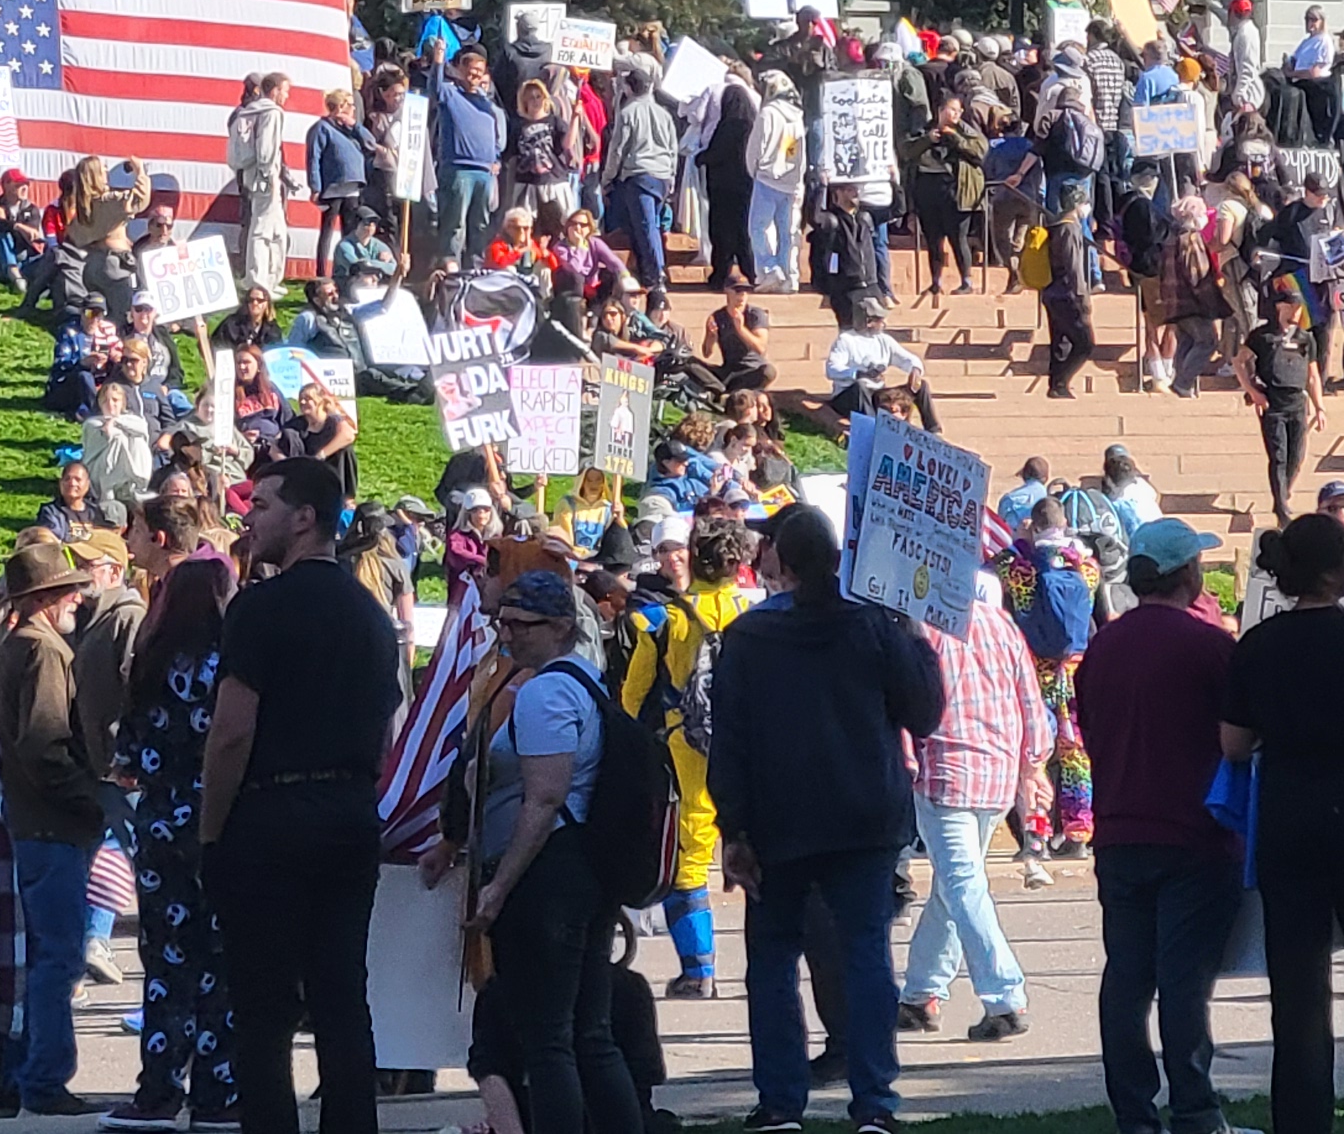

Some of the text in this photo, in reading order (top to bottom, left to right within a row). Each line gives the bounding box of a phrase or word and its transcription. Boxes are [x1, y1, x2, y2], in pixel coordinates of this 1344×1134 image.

[556, 49, 602, 66] FOR ALL
[866, 140, 888, 161] ICE
[148, 245, 225, 281] Genocide
[156, 270, 226, 316] BAD
[465, 364, 509, 397] DA
[511, 367, 581, 390] ELECT A
[605, 367, 650, 395] KINGS!
[520, 390, 576, 414] RAPIST
[445, 409, 520, 452] FURK
[520, 416, 577, 435] XPECT
[507, 446, 578, 472] FUCKED
[604, 455, 633, 475] 1776
[871, 453, 978, 538] AMERICA
